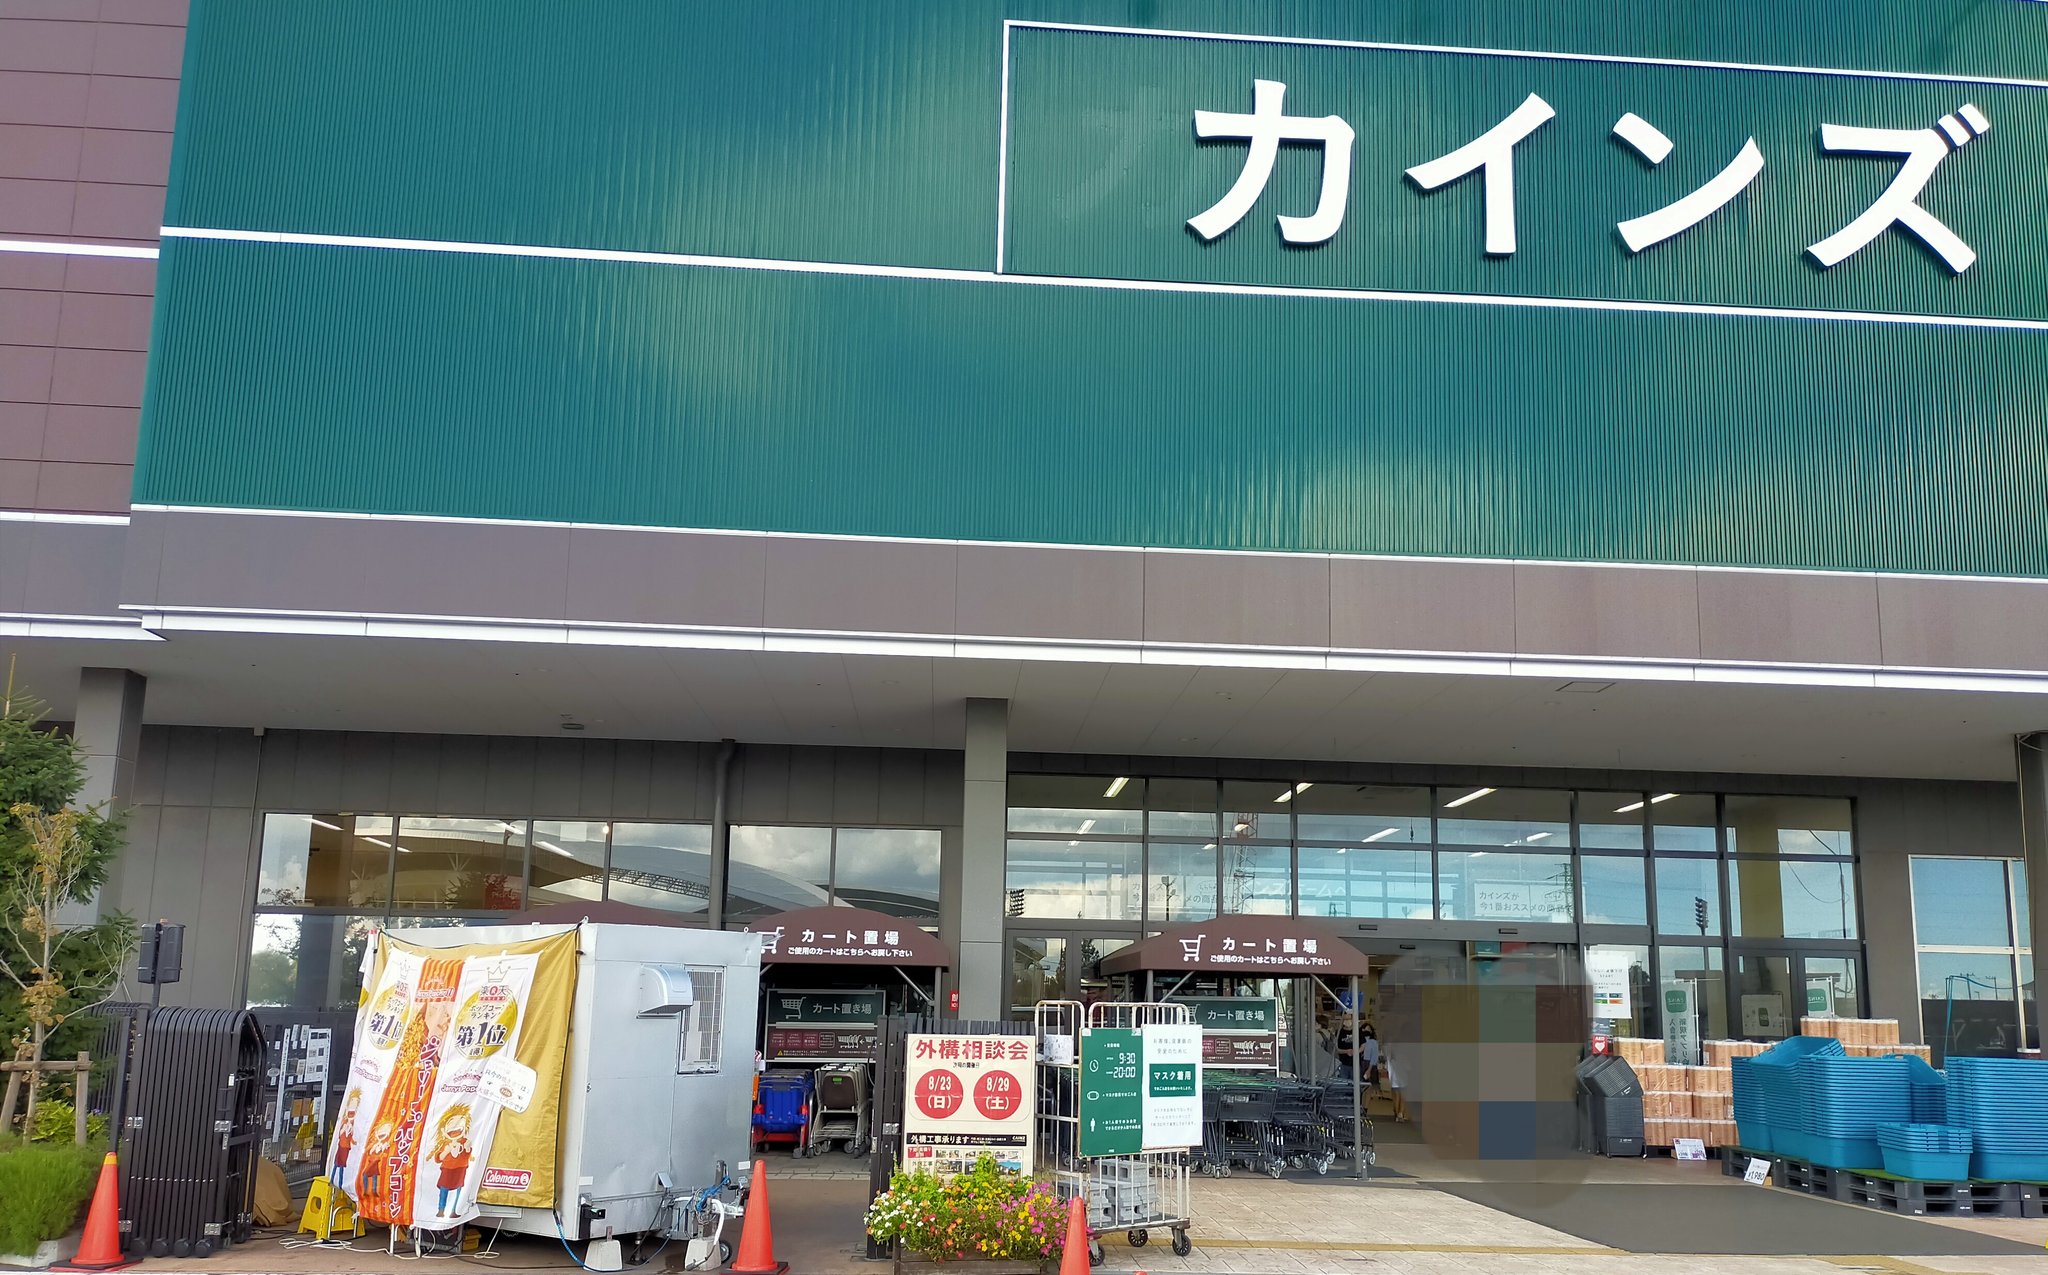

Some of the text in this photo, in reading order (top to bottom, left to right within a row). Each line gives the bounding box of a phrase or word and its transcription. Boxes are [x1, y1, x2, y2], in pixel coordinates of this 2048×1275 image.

[1186, 79, 1990, 275] カインズ
[801, 929, 899, 945] カート置場
[788, 946, 913, 957] ご使用のカートはこちらへお戻し下さい
[1222, 937, 1318, 953] カート置場
[1210, 954, 1332, 965] ご使用のカートはこちらへお戻し下さい
[812, 1003, 873, 1014] カート置き場
[1207, 1010, 1265, 1021] カート置き場
[456, 1021, 507, 1048] 第1位
[916, 1039, 1028, 1061] 外構相談会
[1119, 1052, 1136, 1064] 9:30
[928, 1076, 952, 1091] 8/23
[1153, 1071, 1191, 1081] マスク着用
[986, 1077, 1010, 1092] 8/29
[485, 1170, 520, 1185] Coleman
